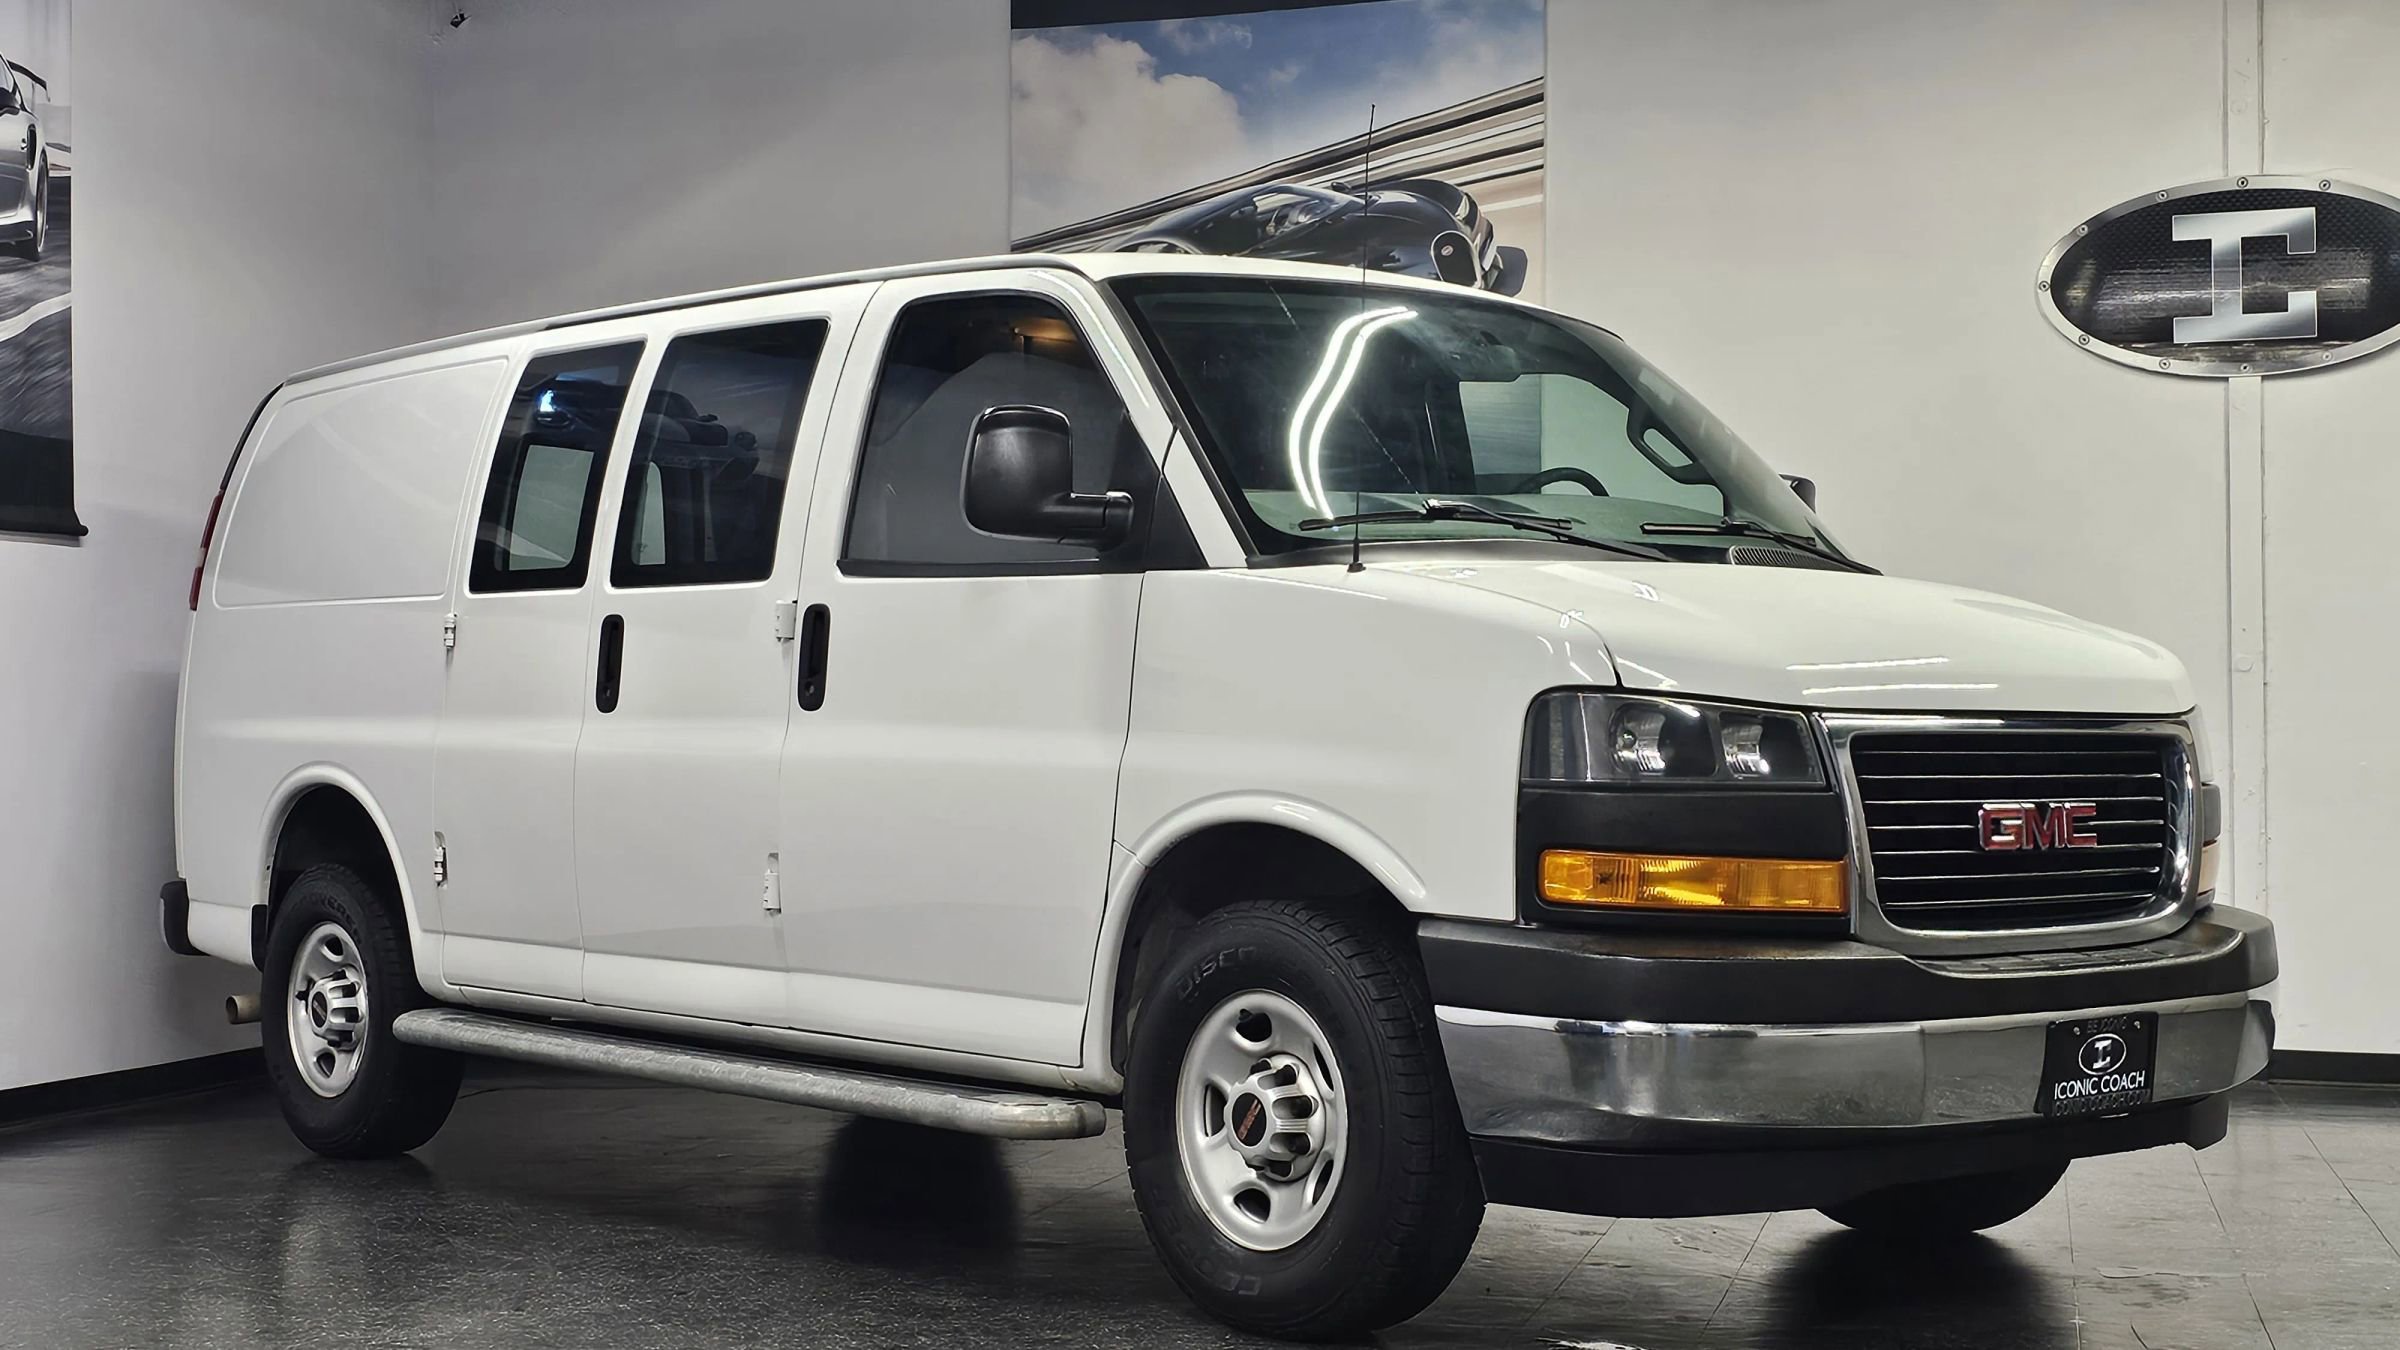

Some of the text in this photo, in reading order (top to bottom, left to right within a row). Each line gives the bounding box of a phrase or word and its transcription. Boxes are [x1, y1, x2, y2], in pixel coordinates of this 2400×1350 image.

[1977, 802, 2098, 850] GMC
[2053, 1069, 2146, 1101] ICONIC COACH
